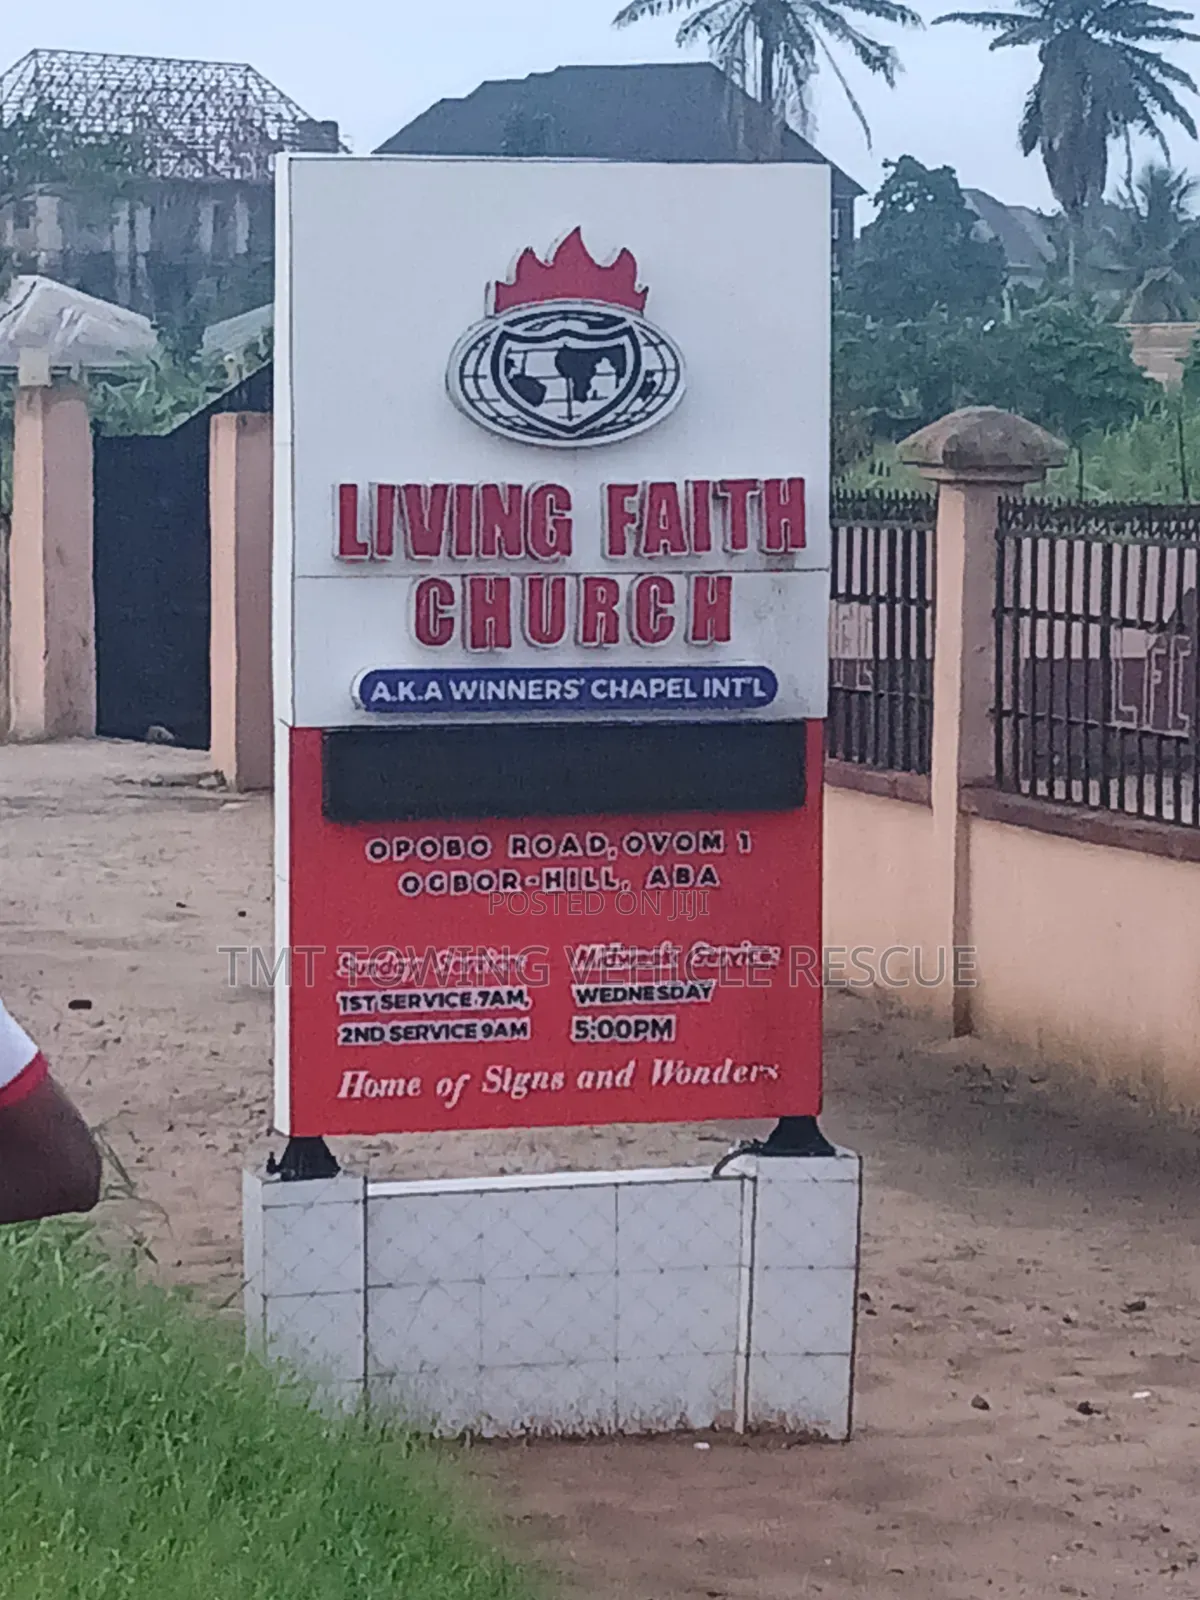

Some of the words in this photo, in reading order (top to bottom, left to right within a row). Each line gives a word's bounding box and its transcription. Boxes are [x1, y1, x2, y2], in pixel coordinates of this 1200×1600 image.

[337, 482, 574, 560] LIVING
[604, 477, 808, 556] FAITH
[412, 574, 733, 650] CHURCH
[370, 681, 444, 702] A.K.A
[449, 679, 585, 700] WINNERS'
[591, 678, 698, 699] CHAPEL
[703, 677, 767, 698] INT'L
[365, 836, 492, 862] OPOBO
[737, 830, 752, 853] 1
[645, 864, 720, 889] ABA
[337, 949, 425, 981] Sunday
[339, 994, 376, 1013] 1ST
[380, 991, 473, 1009] SERVICE
[574, 983, 713, 1005] WEDNESDAY
[340, 1024, 386, 1043] 2ND
[389, 1022, 478, 1041] SERVICE
[481, 1021, 529, 1039] 9AM
[573, 1017, 674, 1040] 5:00PM
[336, 1070, 421, 1098] Home
[436, 1074, 471, 1109] of
[482, 1065, 565, 1099] Signs
[576, 1059, 637, 1089] and
[651, 1058, 780, 1086] Wonders
